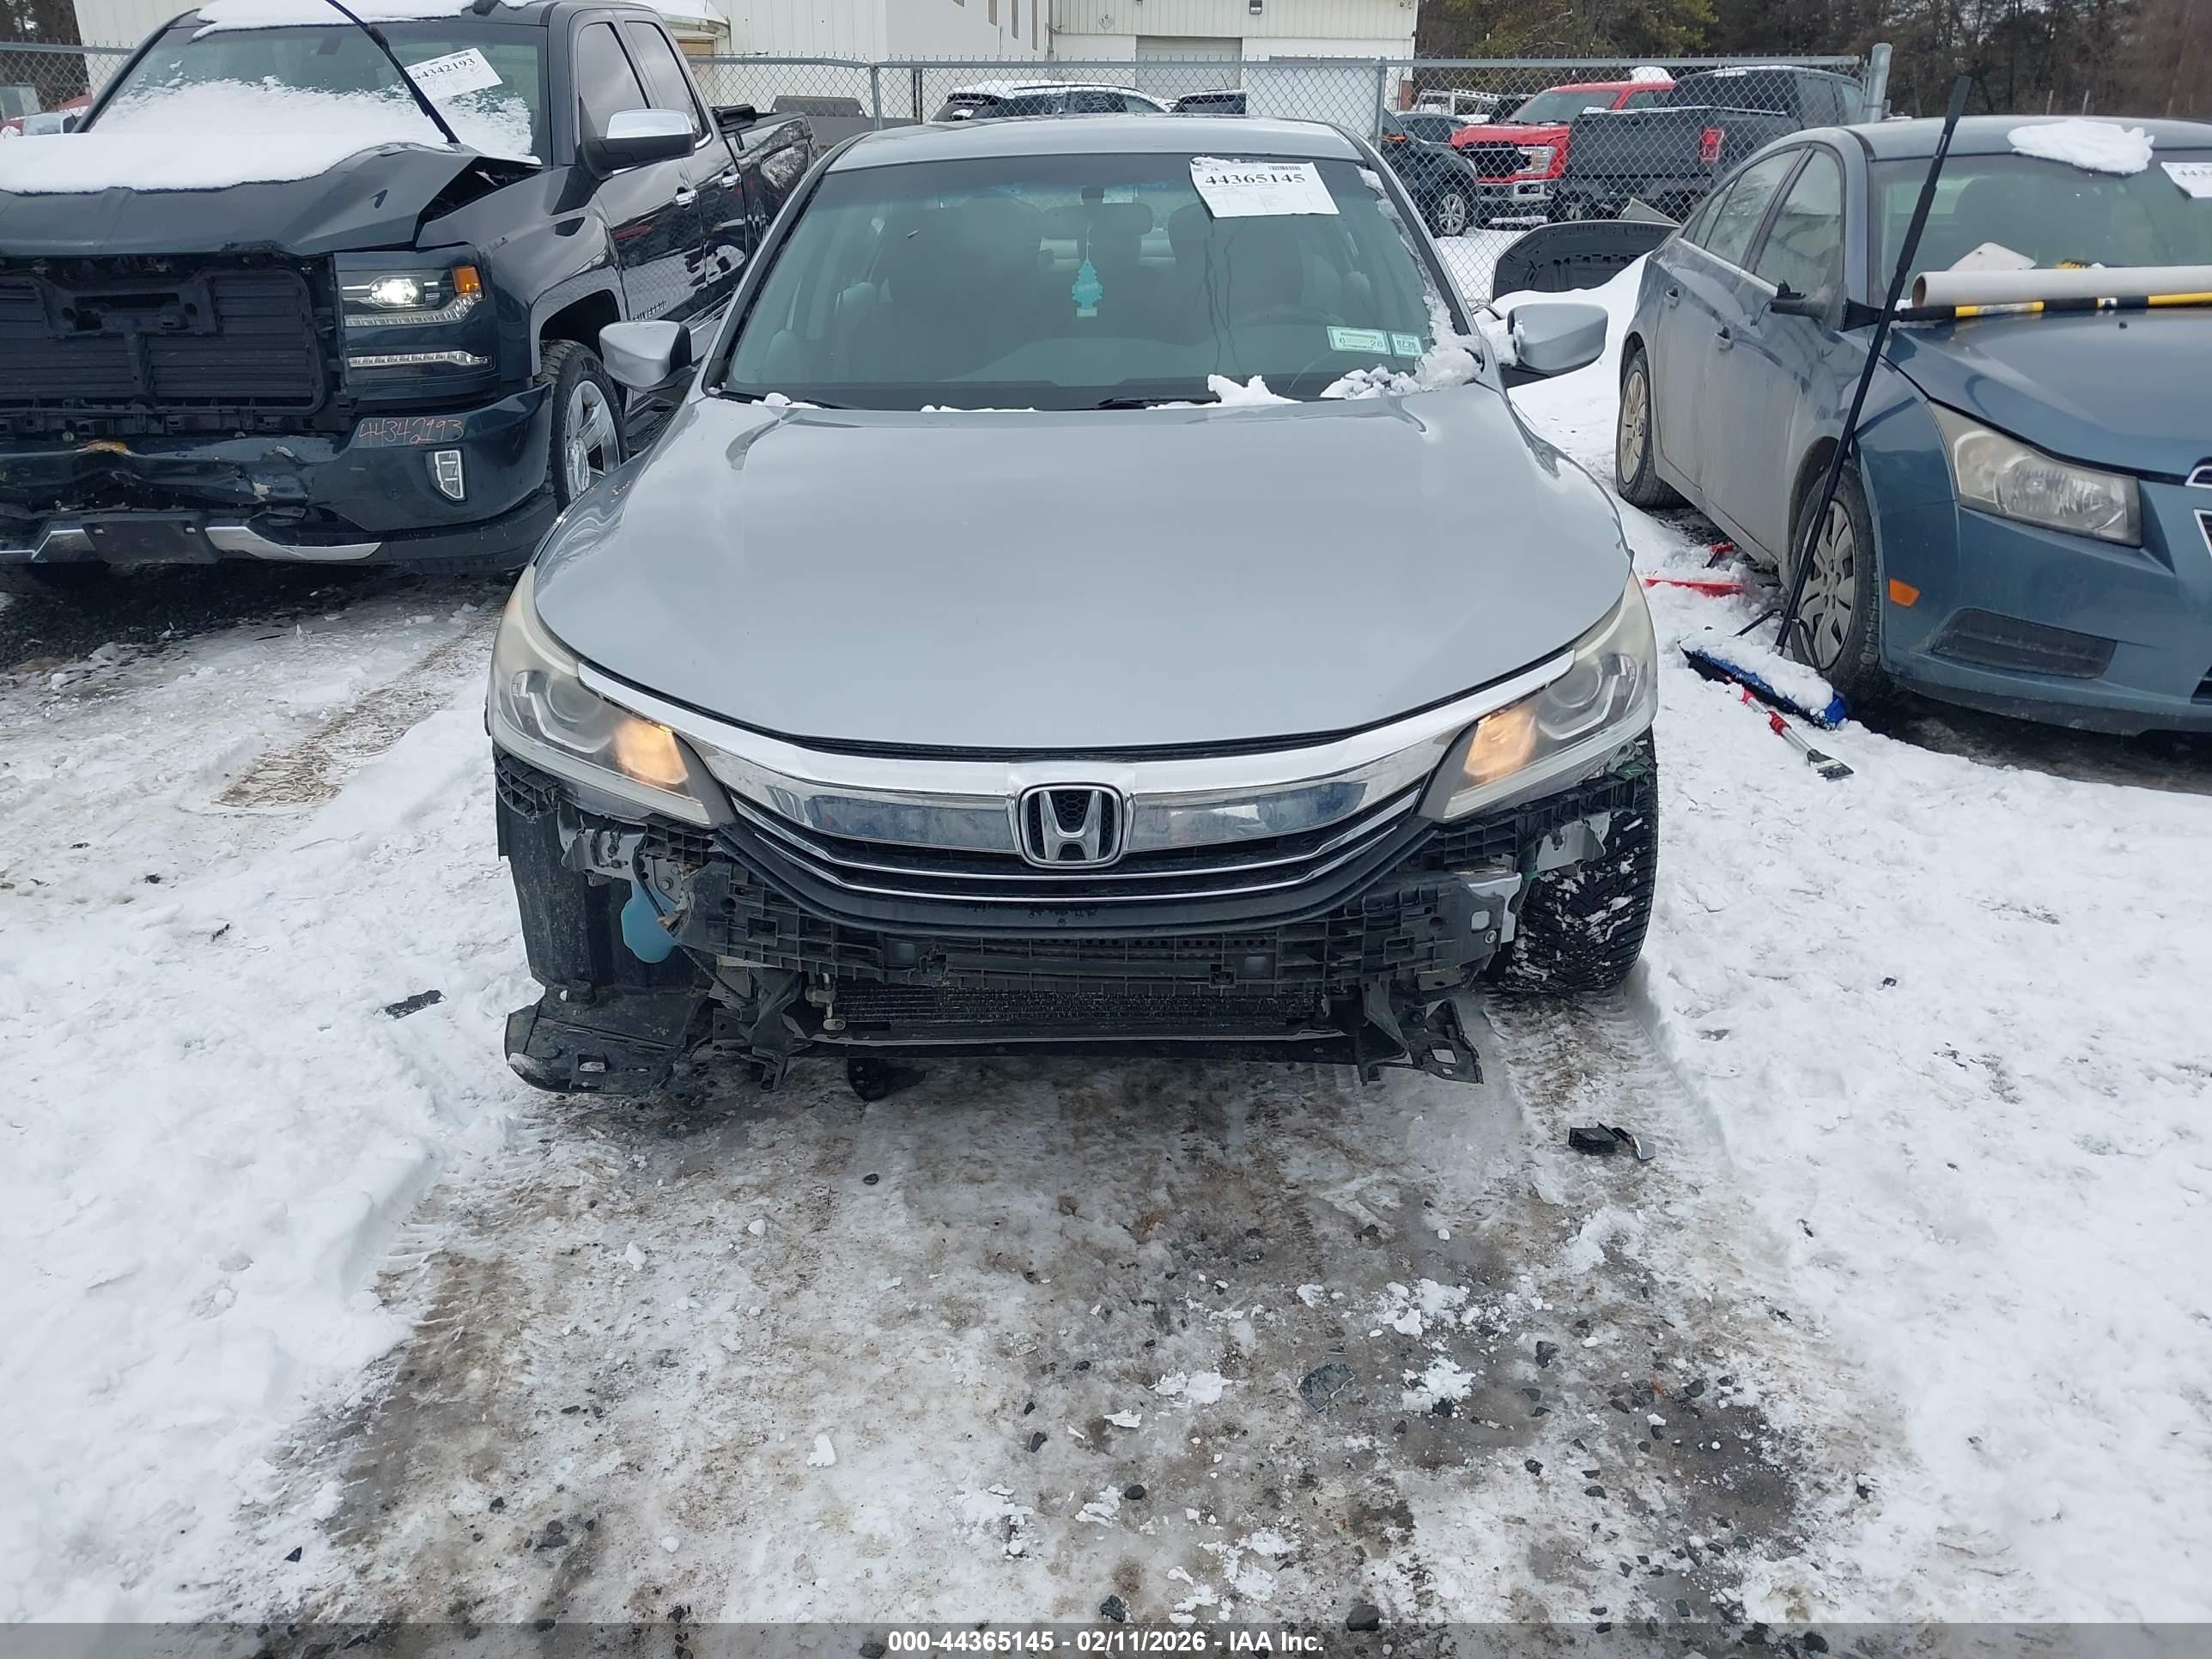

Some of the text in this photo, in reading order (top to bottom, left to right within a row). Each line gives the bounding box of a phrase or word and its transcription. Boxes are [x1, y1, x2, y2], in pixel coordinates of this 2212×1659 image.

[413, 58, 476, 81] 44342193
[1206, 173, 1306, 185] 44365145
[359, 417, 464, 447] 44342193
